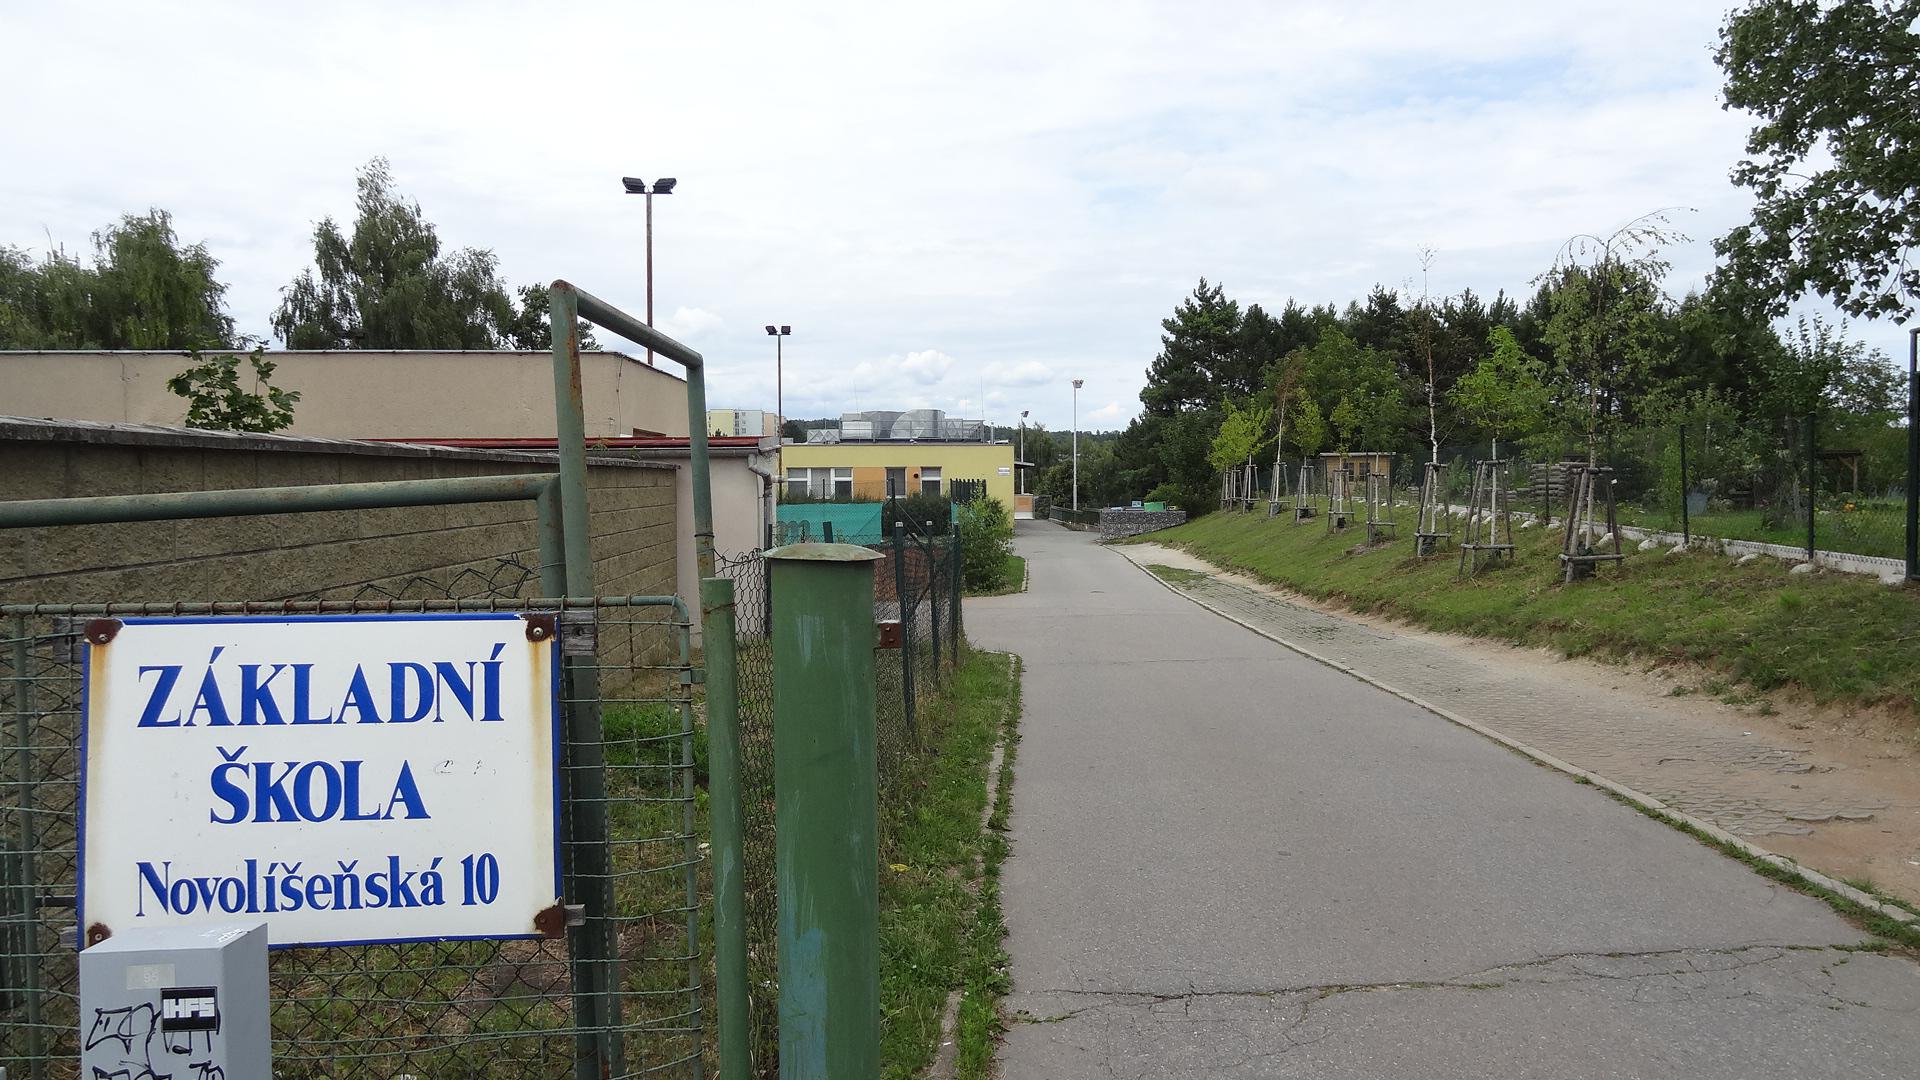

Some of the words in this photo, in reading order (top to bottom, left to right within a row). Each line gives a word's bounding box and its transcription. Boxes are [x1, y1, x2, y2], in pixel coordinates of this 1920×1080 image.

[138, 643, 505, 728] ZÁKLADNÍ
[210, 745, 431, 824] ŠKOLA
[136, 855, 445, 916] Novolíšeňská
[461, 853, 500, 906] 10
